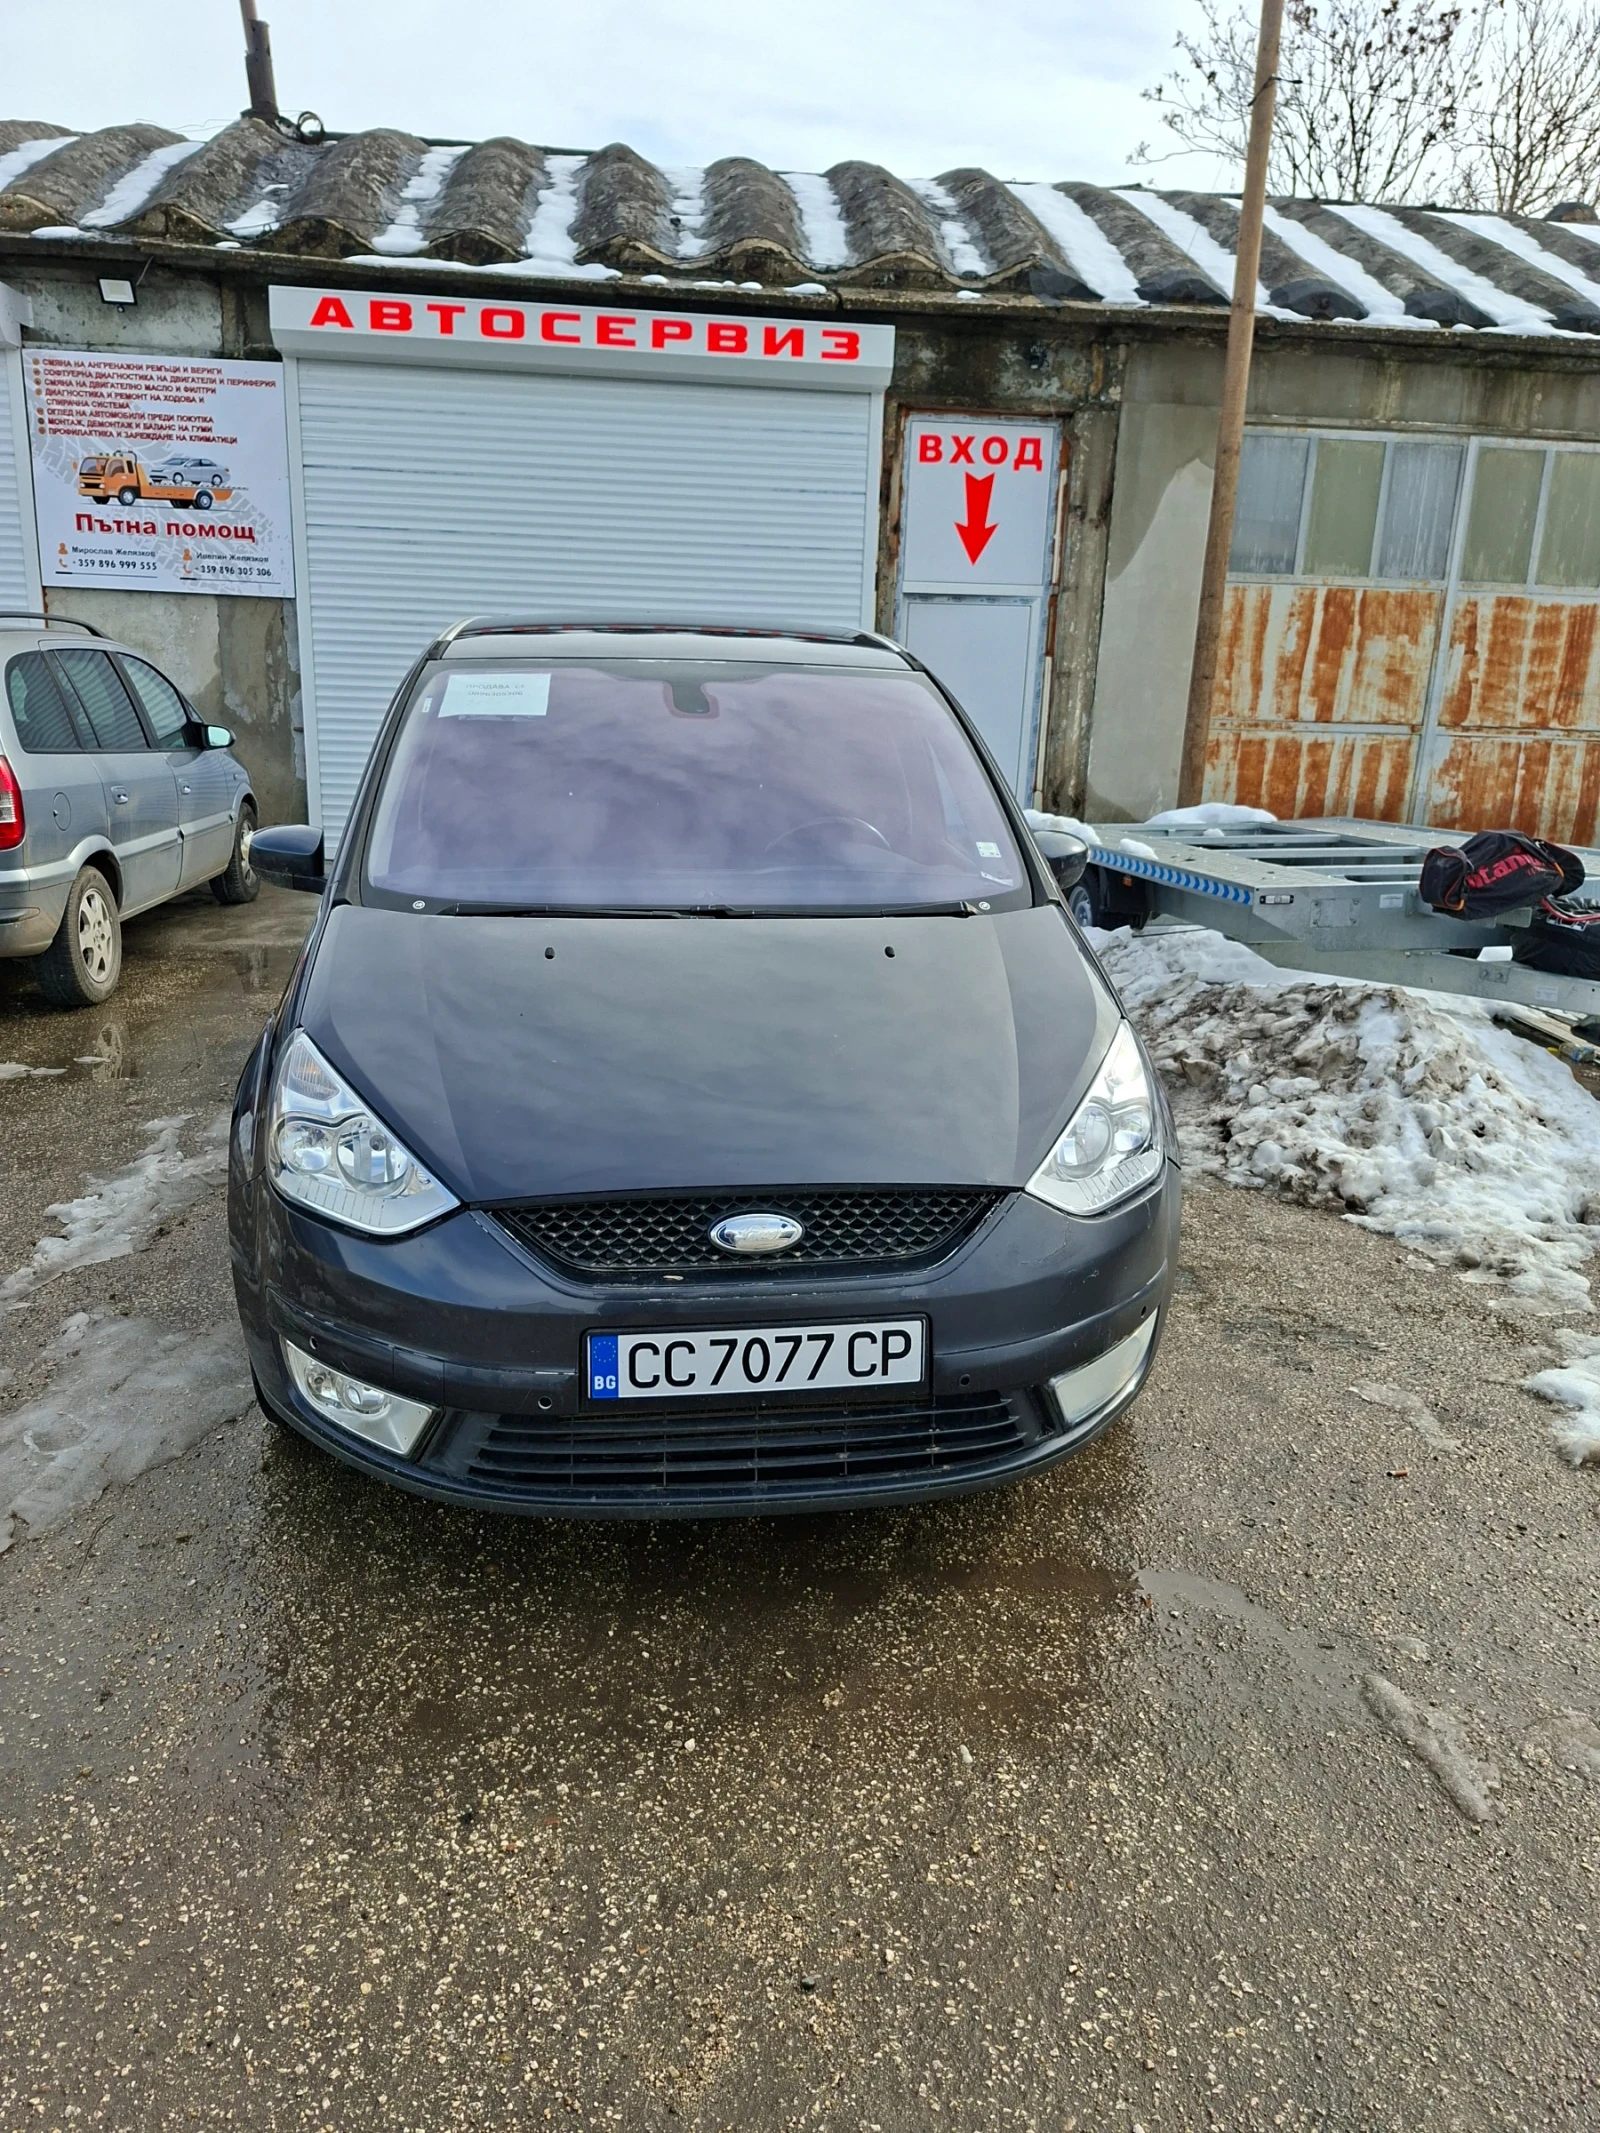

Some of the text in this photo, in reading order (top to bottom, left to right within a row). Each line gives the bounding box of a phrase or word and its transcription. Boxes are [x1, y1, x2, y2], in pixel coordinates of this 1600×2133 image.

[309, 296, 860, 361] АВТОСЕРВИЗ
[919, 434, 1043, 472] ВХОД
[75, 513, 256, 544] Пътна помощ
[98, 559, 116, 569] 896
[119, 560, 137, 569] 999
[140, 561, 157, 571] 555
[708, 1332, 835, 1386] 7077
[594, 1375, 616, 1391] BG
